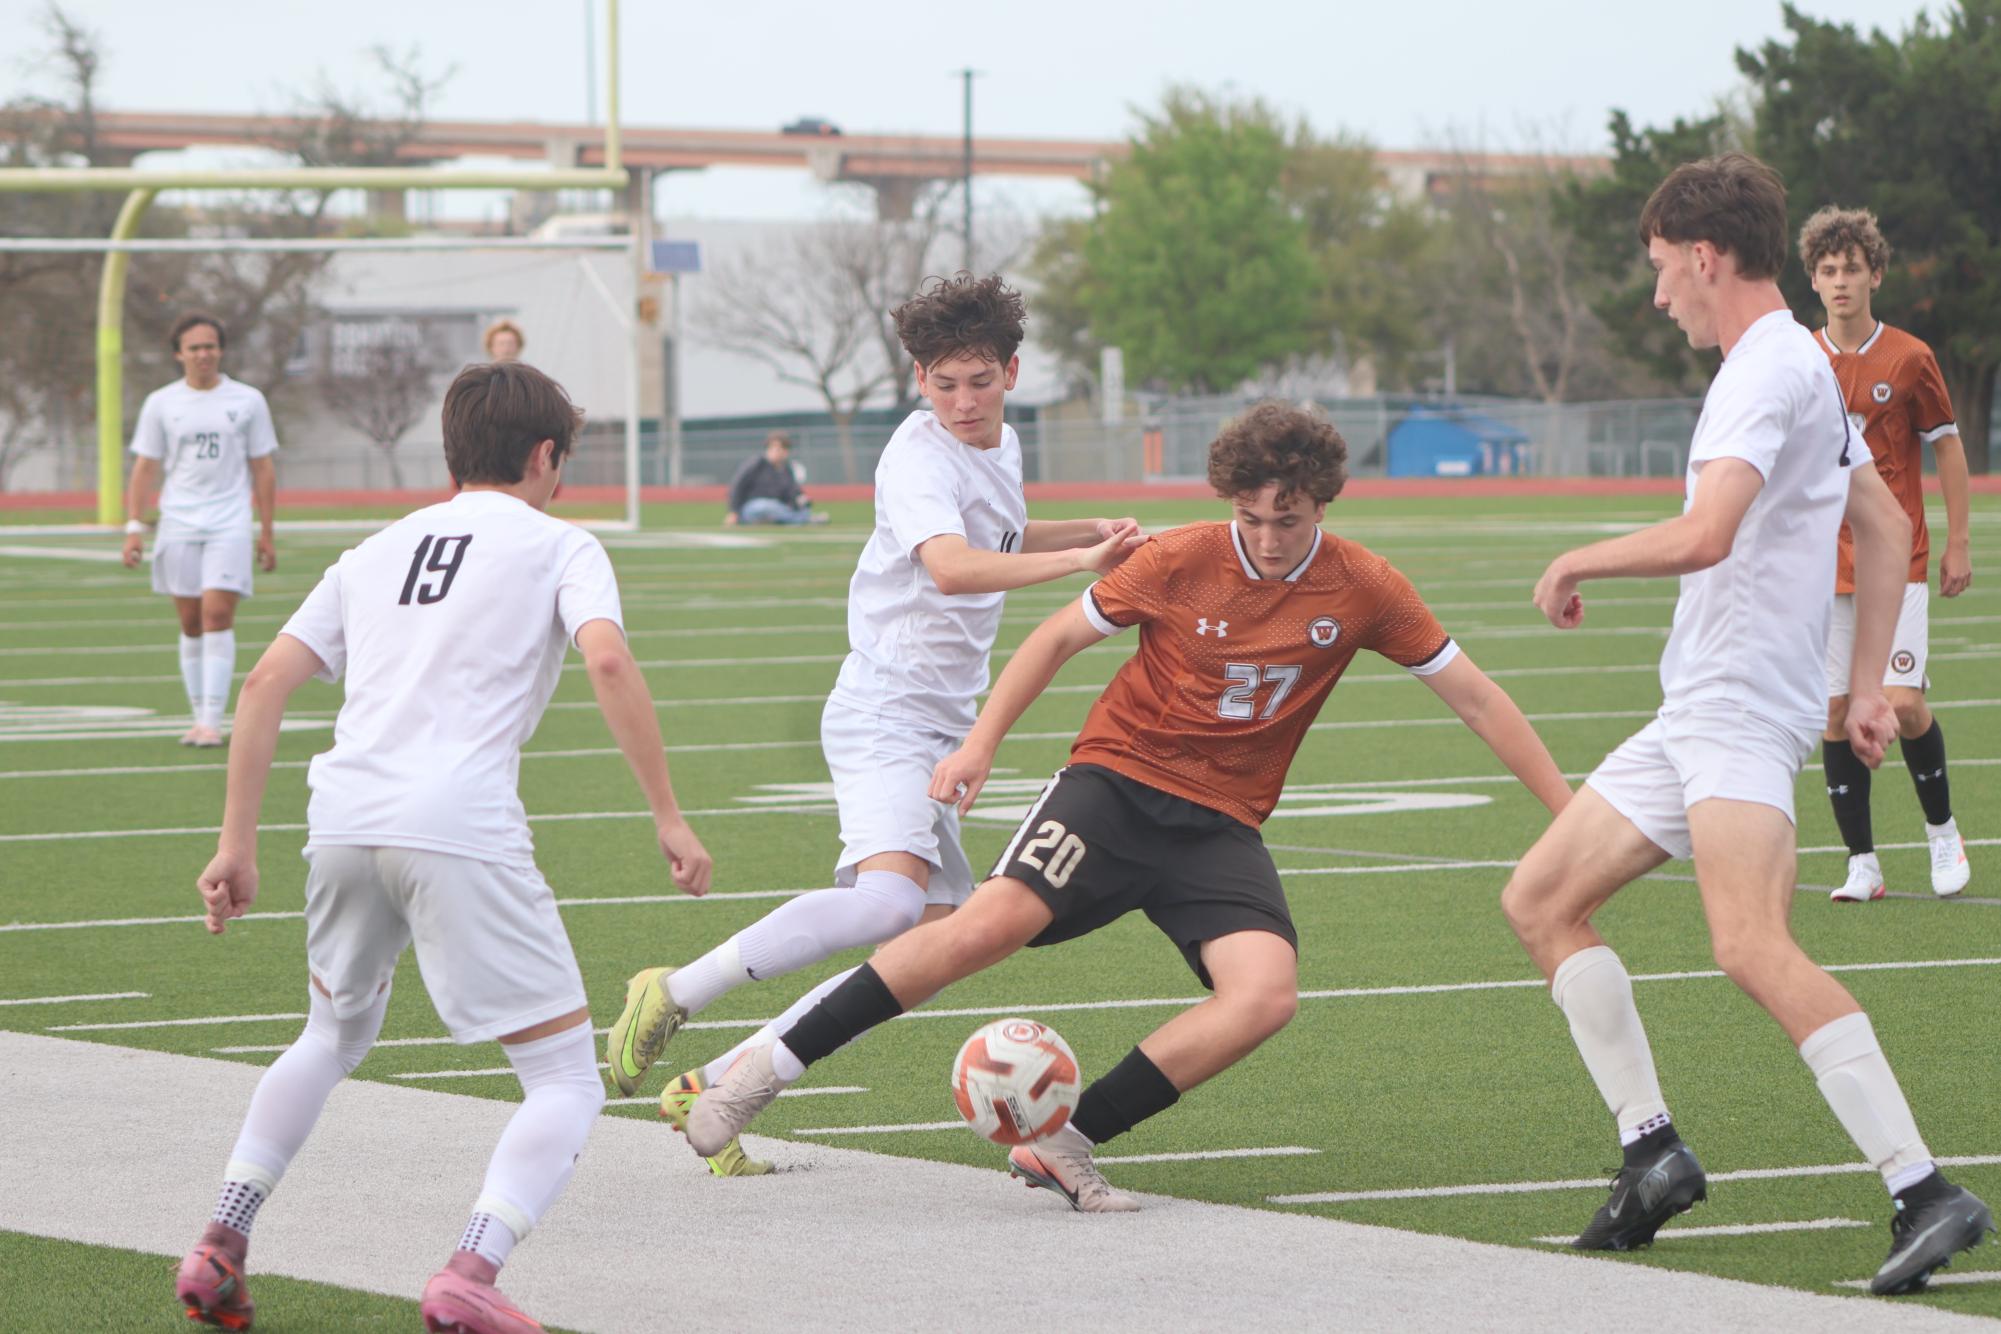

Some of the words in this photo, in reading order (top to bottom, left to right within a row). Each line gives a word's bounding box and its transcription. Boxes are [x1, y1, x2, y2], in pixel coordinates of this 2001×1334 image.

[196, 431, 219, 459] 26
[399, 533, 473, 605] 19
[1218, 663, 1302, 720] 27
[1018, 820, 1086, 889] 20
